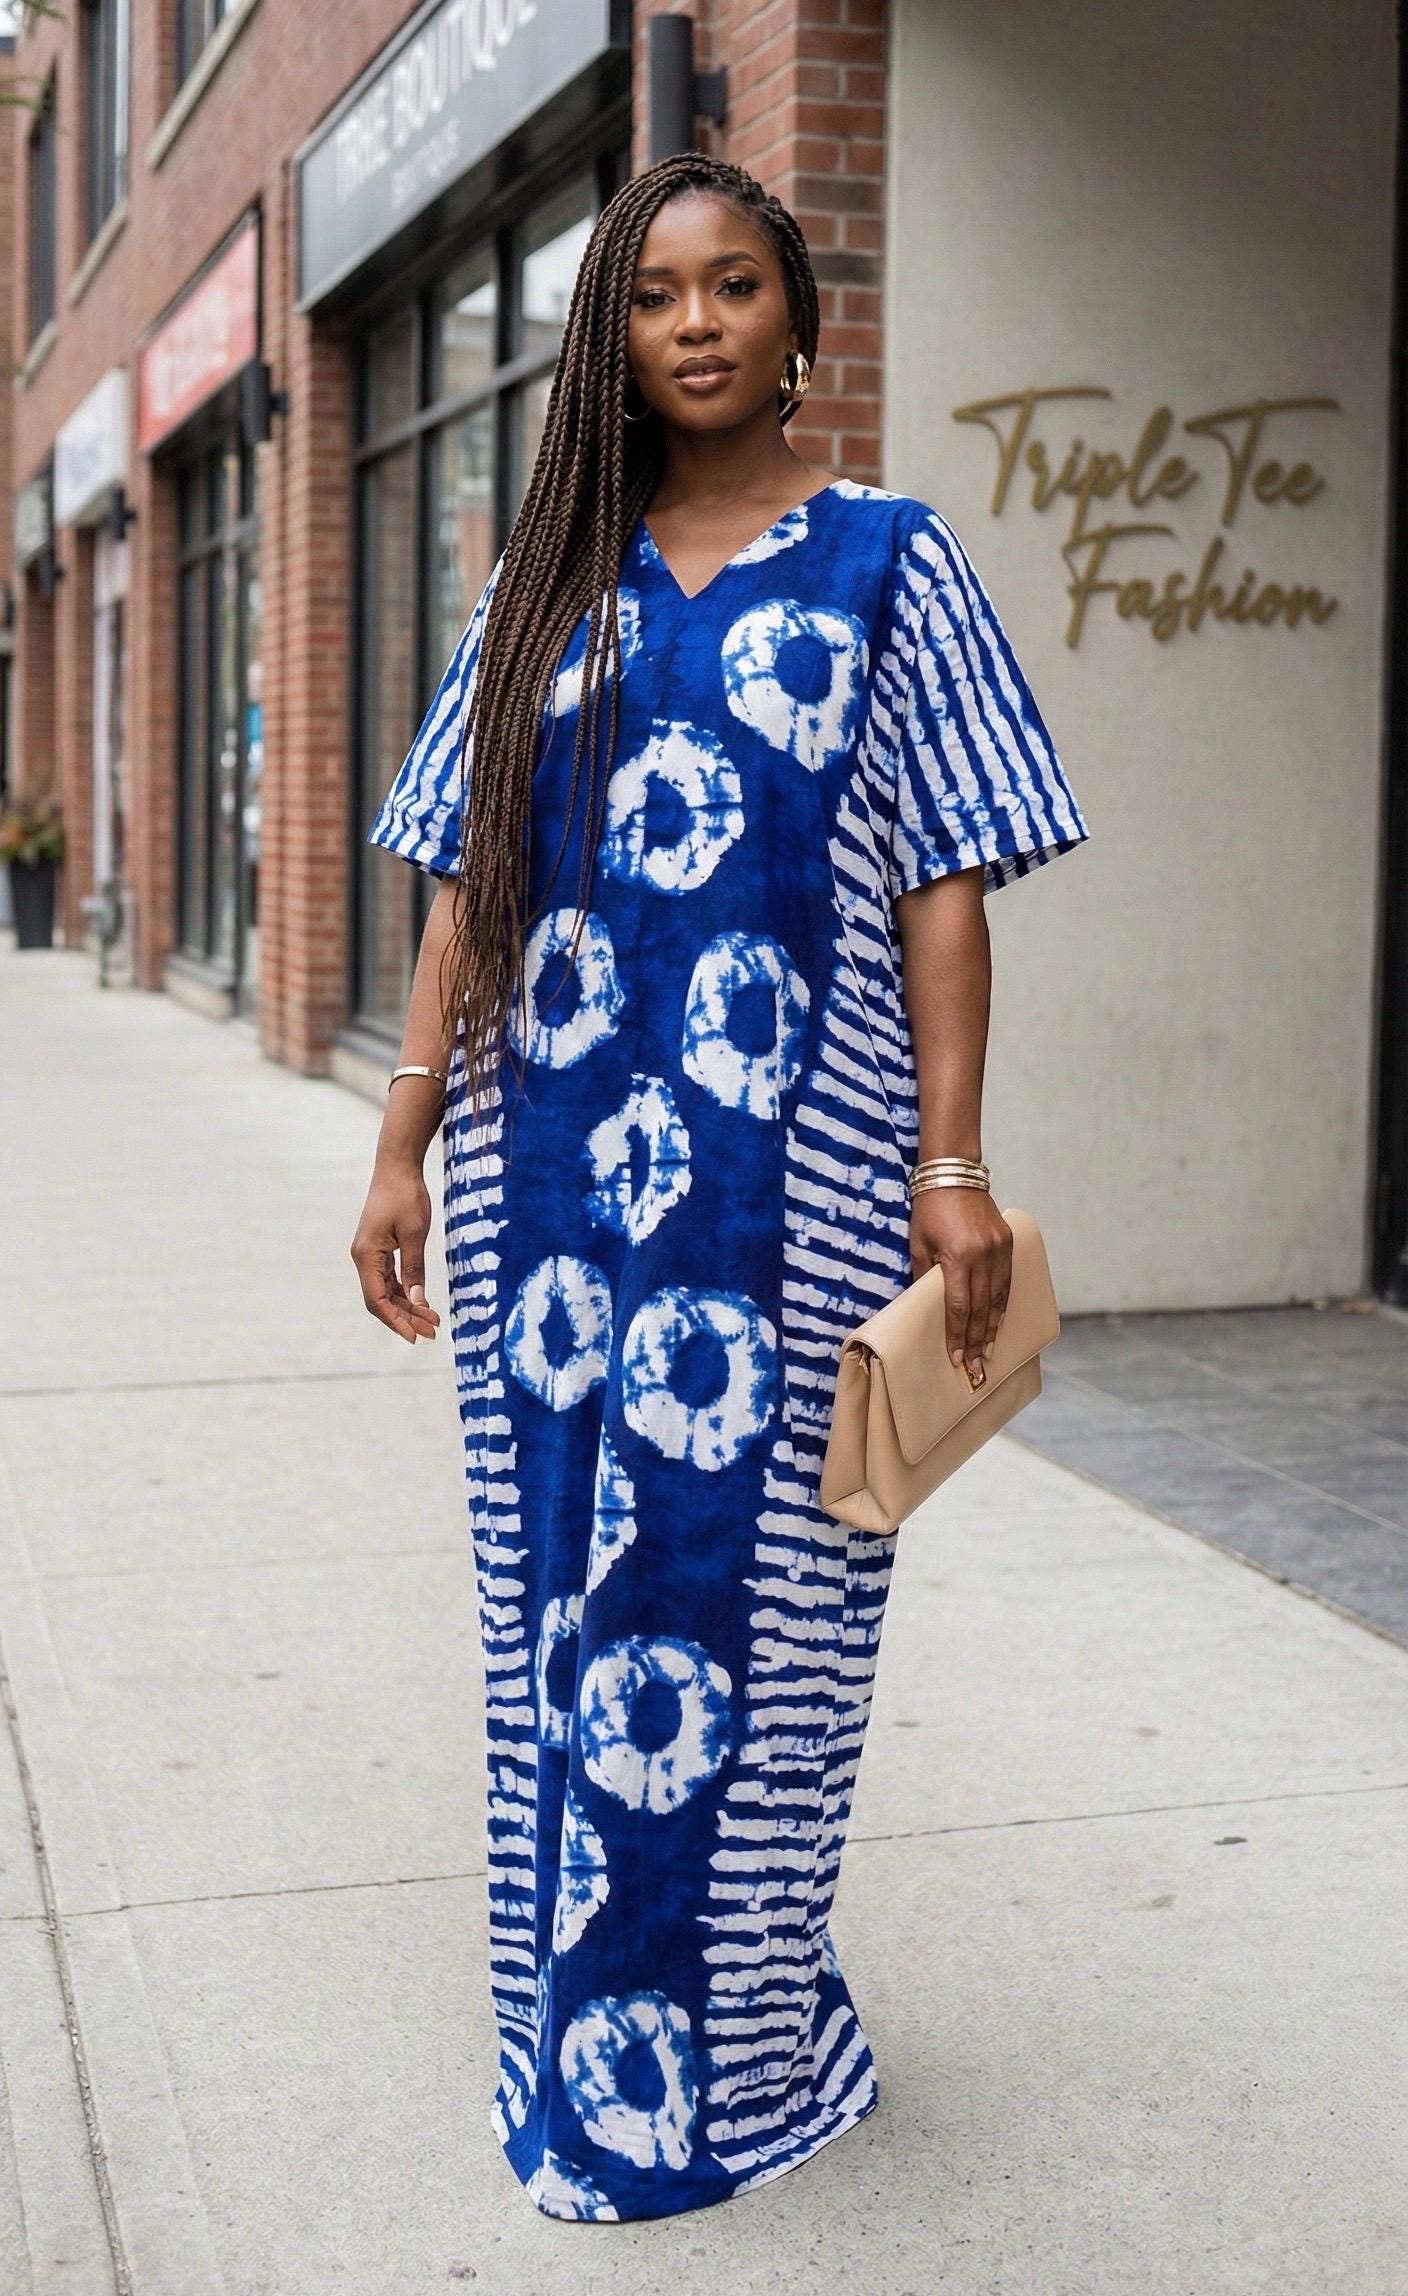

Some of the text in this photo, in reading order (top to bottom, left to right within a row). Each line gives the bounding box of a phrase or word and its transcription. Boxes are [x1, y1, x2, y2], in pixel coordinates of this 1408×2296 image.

[952, 385, 1341, 545] Triple Tee
[1061, 522, 1341, 650] Fashion
